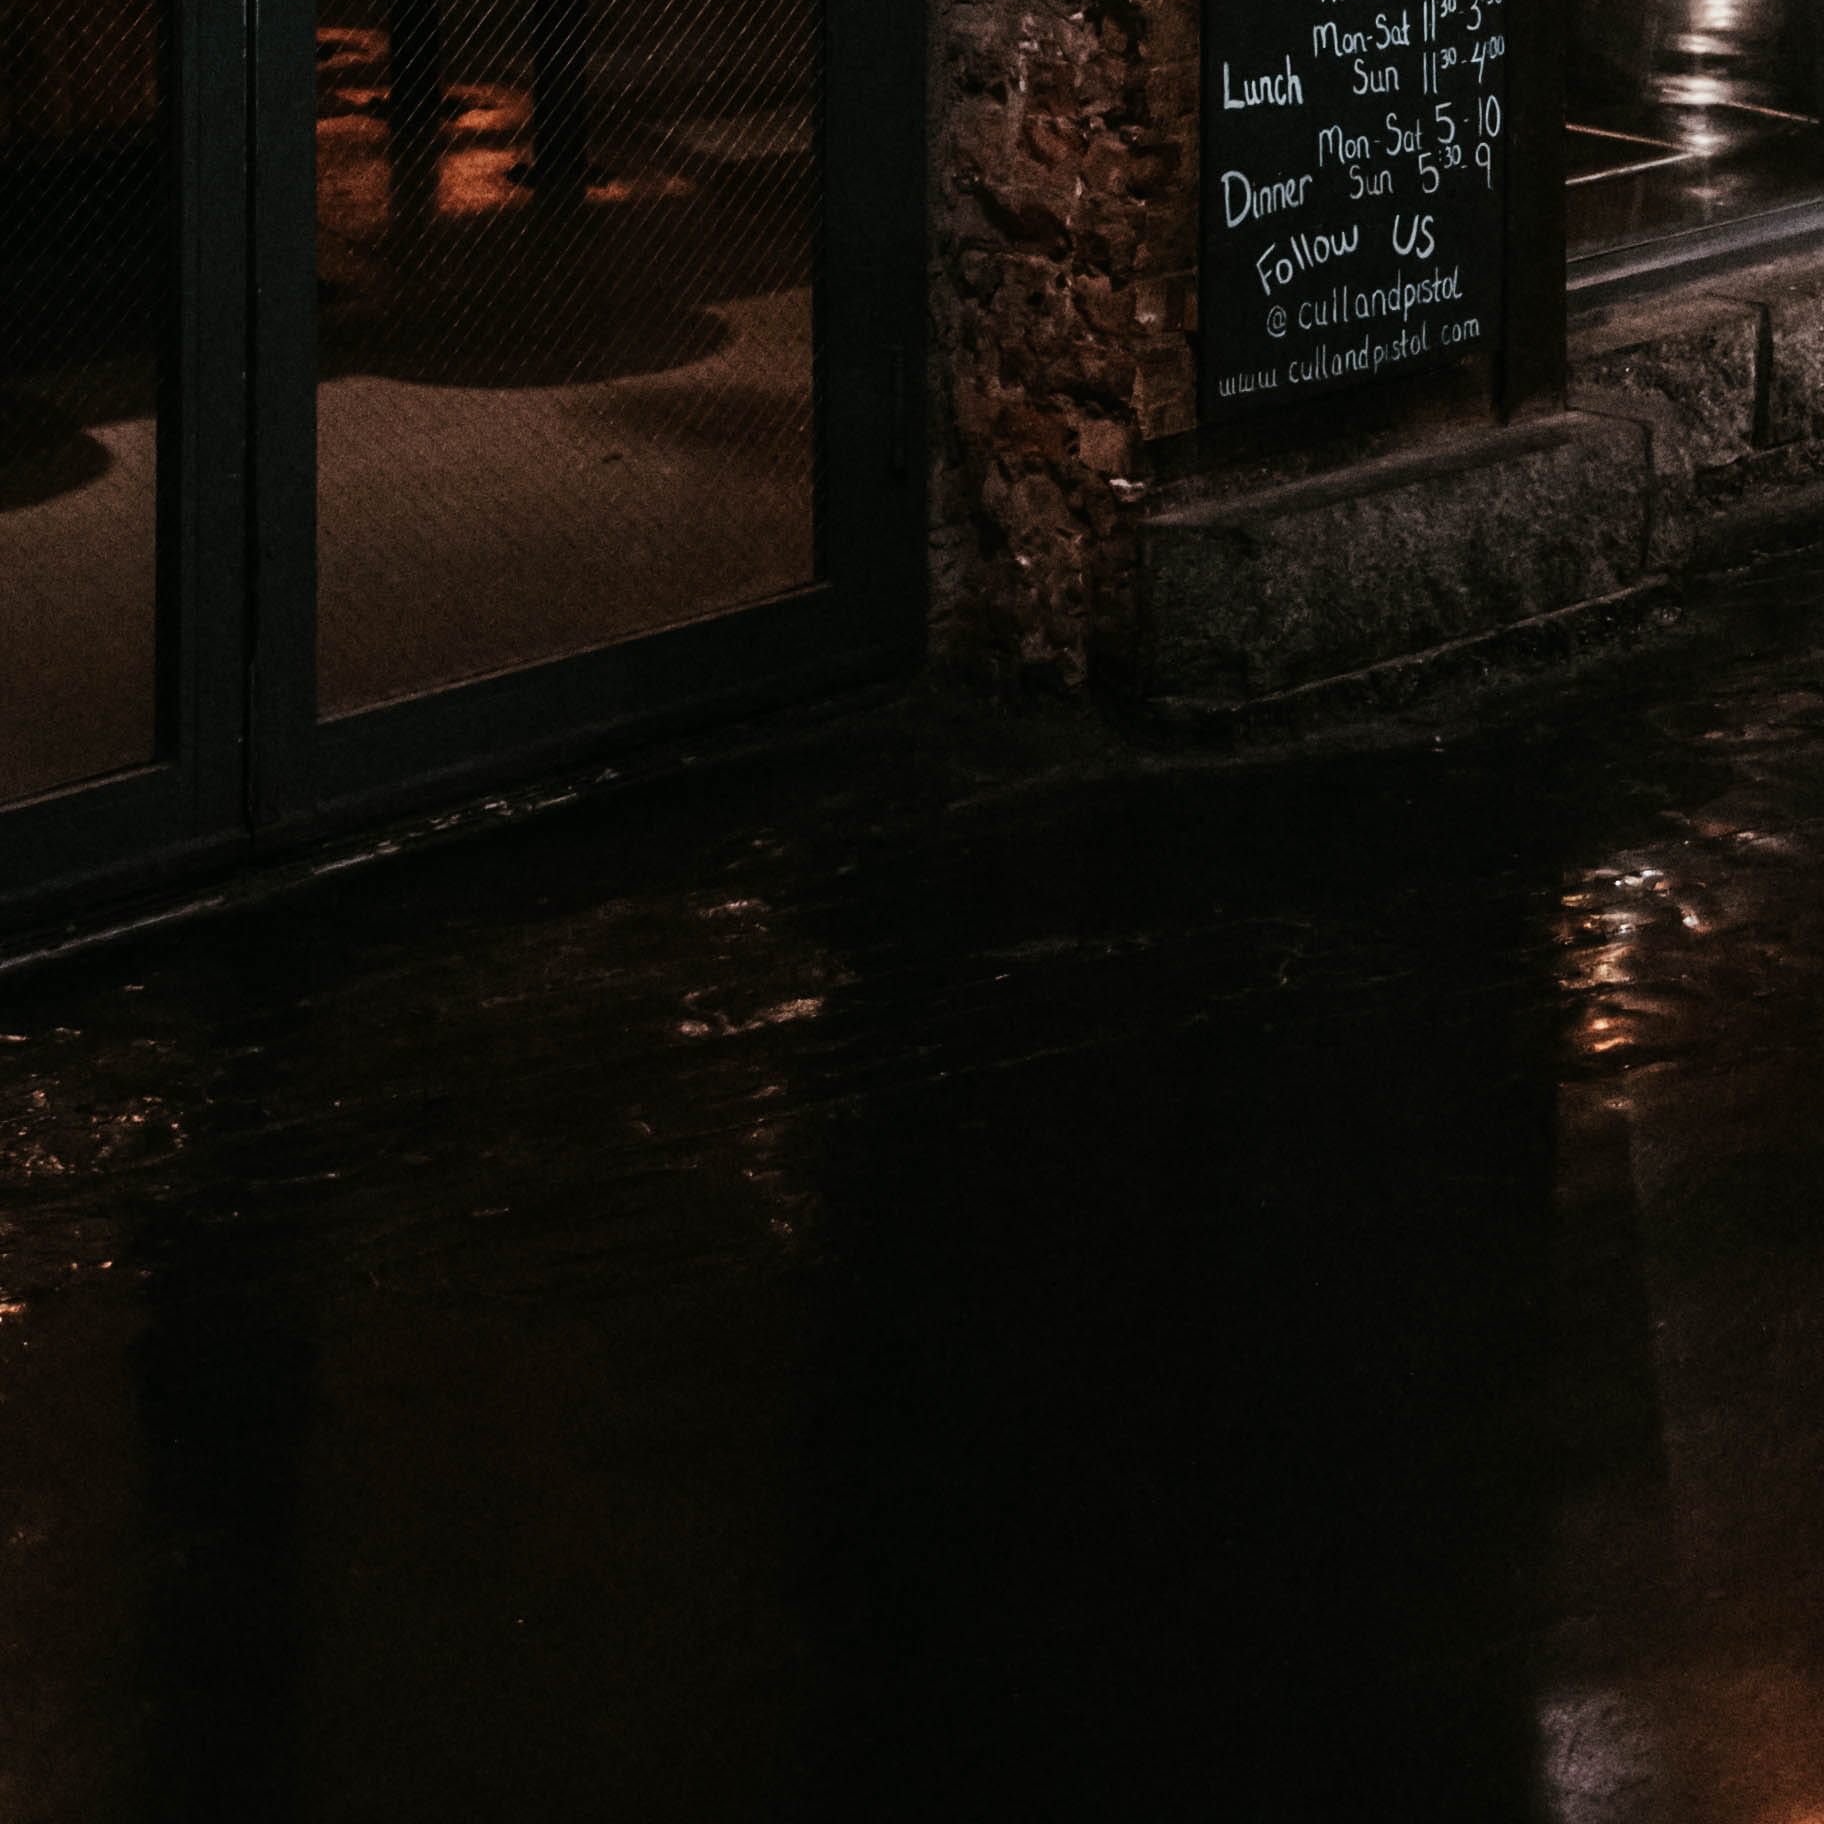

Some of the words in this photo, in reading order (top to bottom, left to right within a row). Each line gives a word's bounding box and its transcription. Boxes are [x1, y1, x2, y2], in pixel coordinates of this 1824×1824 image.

[1223, 53, 1304, 111] Lunch
[1352, 57, 1401, 96] Sun
[1220, 169, 1313, 229] Dinner
[1348, 164, 1394, 200] Sun
[1256, 223, 1359, 297] Follow
